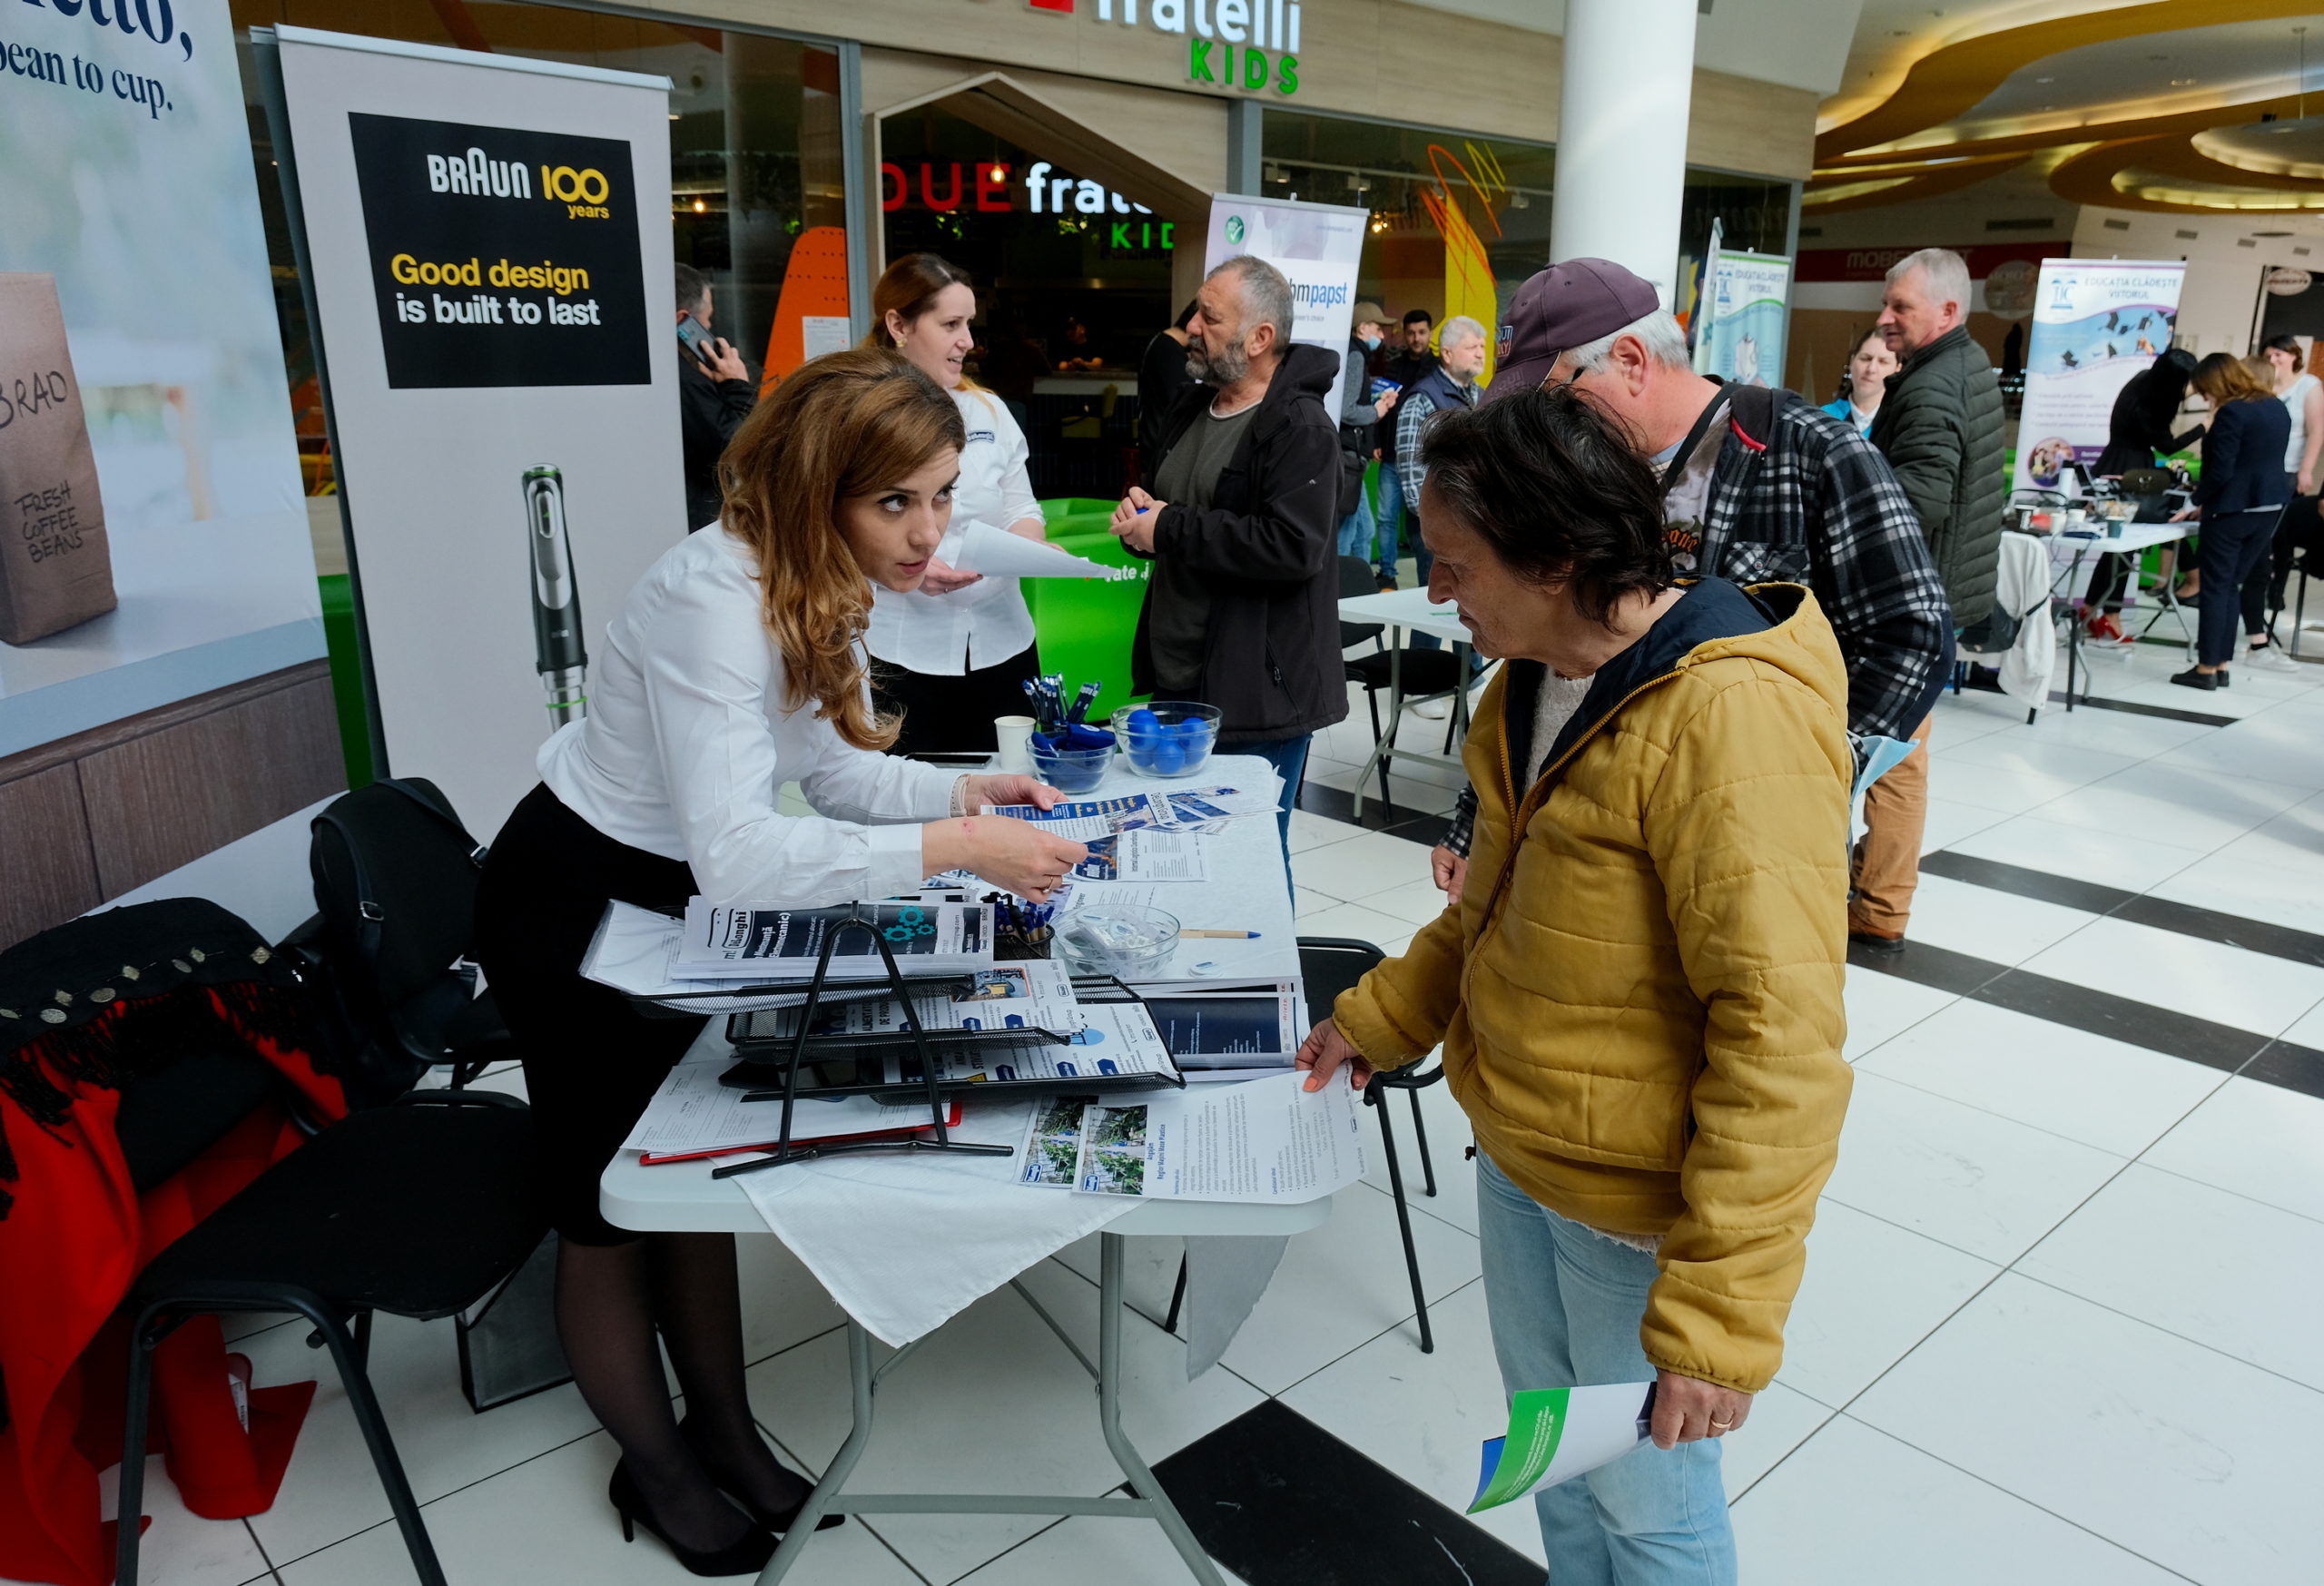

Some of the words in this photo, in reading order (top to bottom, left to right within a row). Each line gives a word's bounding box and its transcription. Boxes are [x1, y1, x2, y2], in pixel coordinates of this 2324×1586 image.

[0, 42, 68, 86] ean
[73, 54, 104, 94] to
[112, 69, 173, 121] cup.
[1191, 38, 1299, 94] KIDS
[427, 147, 532, 200] BRAUN
[542, 165, 610, 204] 100
[881, 163, 1012, 212] DUE
[567, 203, 610, 220] years
[391, 253, 481, 288] Good
[488, 259, 589, 296] design
[1846, 249, 1974, 269] MOBET
[396, 292, 427, 324] is
[434, 294, 502, 327] built
[508, 298, 542, 327] to
[548, 297, 601, 327] last
[1289, 278, 1348, 309] bmpapst
[15, 479, 72, 517] FRESH
[23, 507, 79, 540] COFFEE
[28, 531, 84, 564] BEANS
